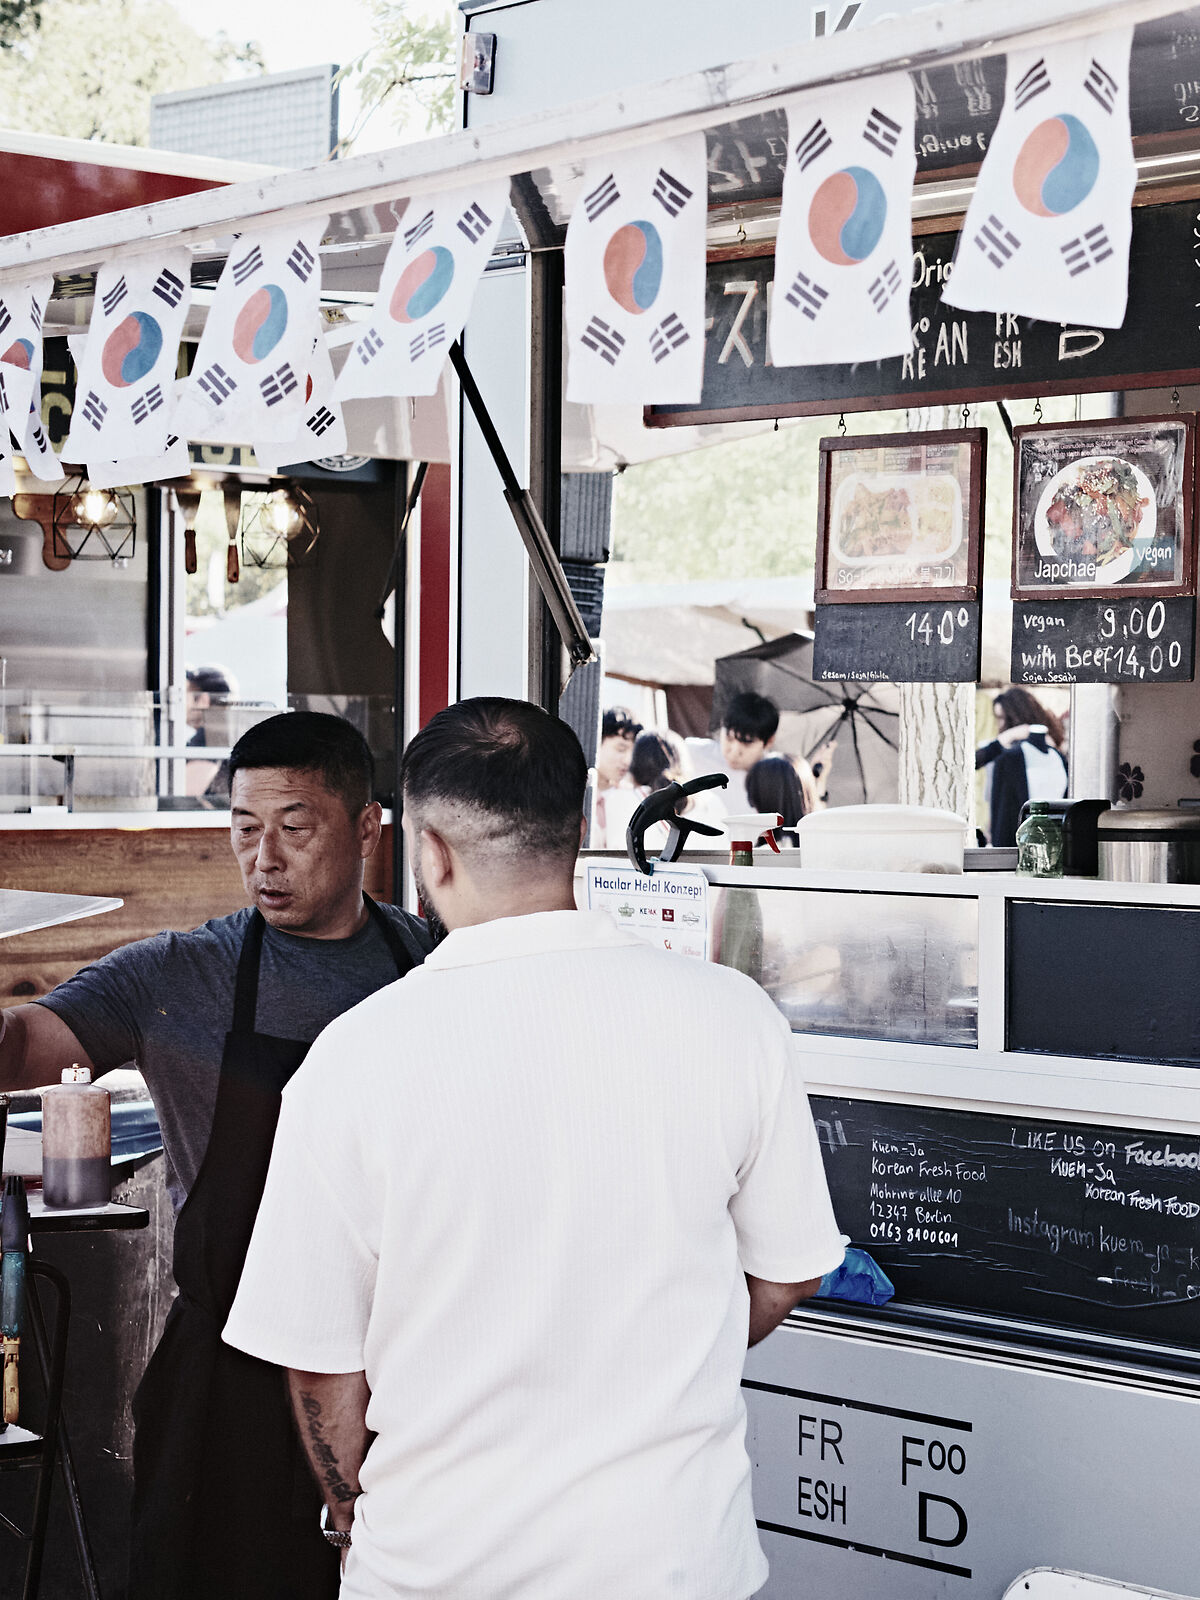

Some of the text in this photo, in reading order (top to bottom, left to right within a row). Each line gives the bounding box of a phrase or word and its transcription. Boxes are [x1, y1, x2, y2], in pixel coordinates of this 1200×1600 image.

[1034, 559, 1096, 582] Japchae
[1021, 643, 1057, 671] with
[634, 878, 661, 893] Helal
[1010, 1127, 1057, 1152] LIKE
[1063, 1134, 1086, 1157] US
[871, 1156, 988, 1183] Korean Fresh Food
[945, 1188, 963, 1205] 10
[1084, 1182, 1126, 1206] Korean
[1128, 1189, 1164, 1213] Fresh
[869, 1200, 953, 1224] 12347 Berlin
[869, 1221, 902, 1243] 0163
[1007, 1207, 1095, 1253] Instagram
[798, 1413, 845, 1465] FR
[797, 1475, 847, 1525] ESH
[918, 1490, 969, 1548] D
